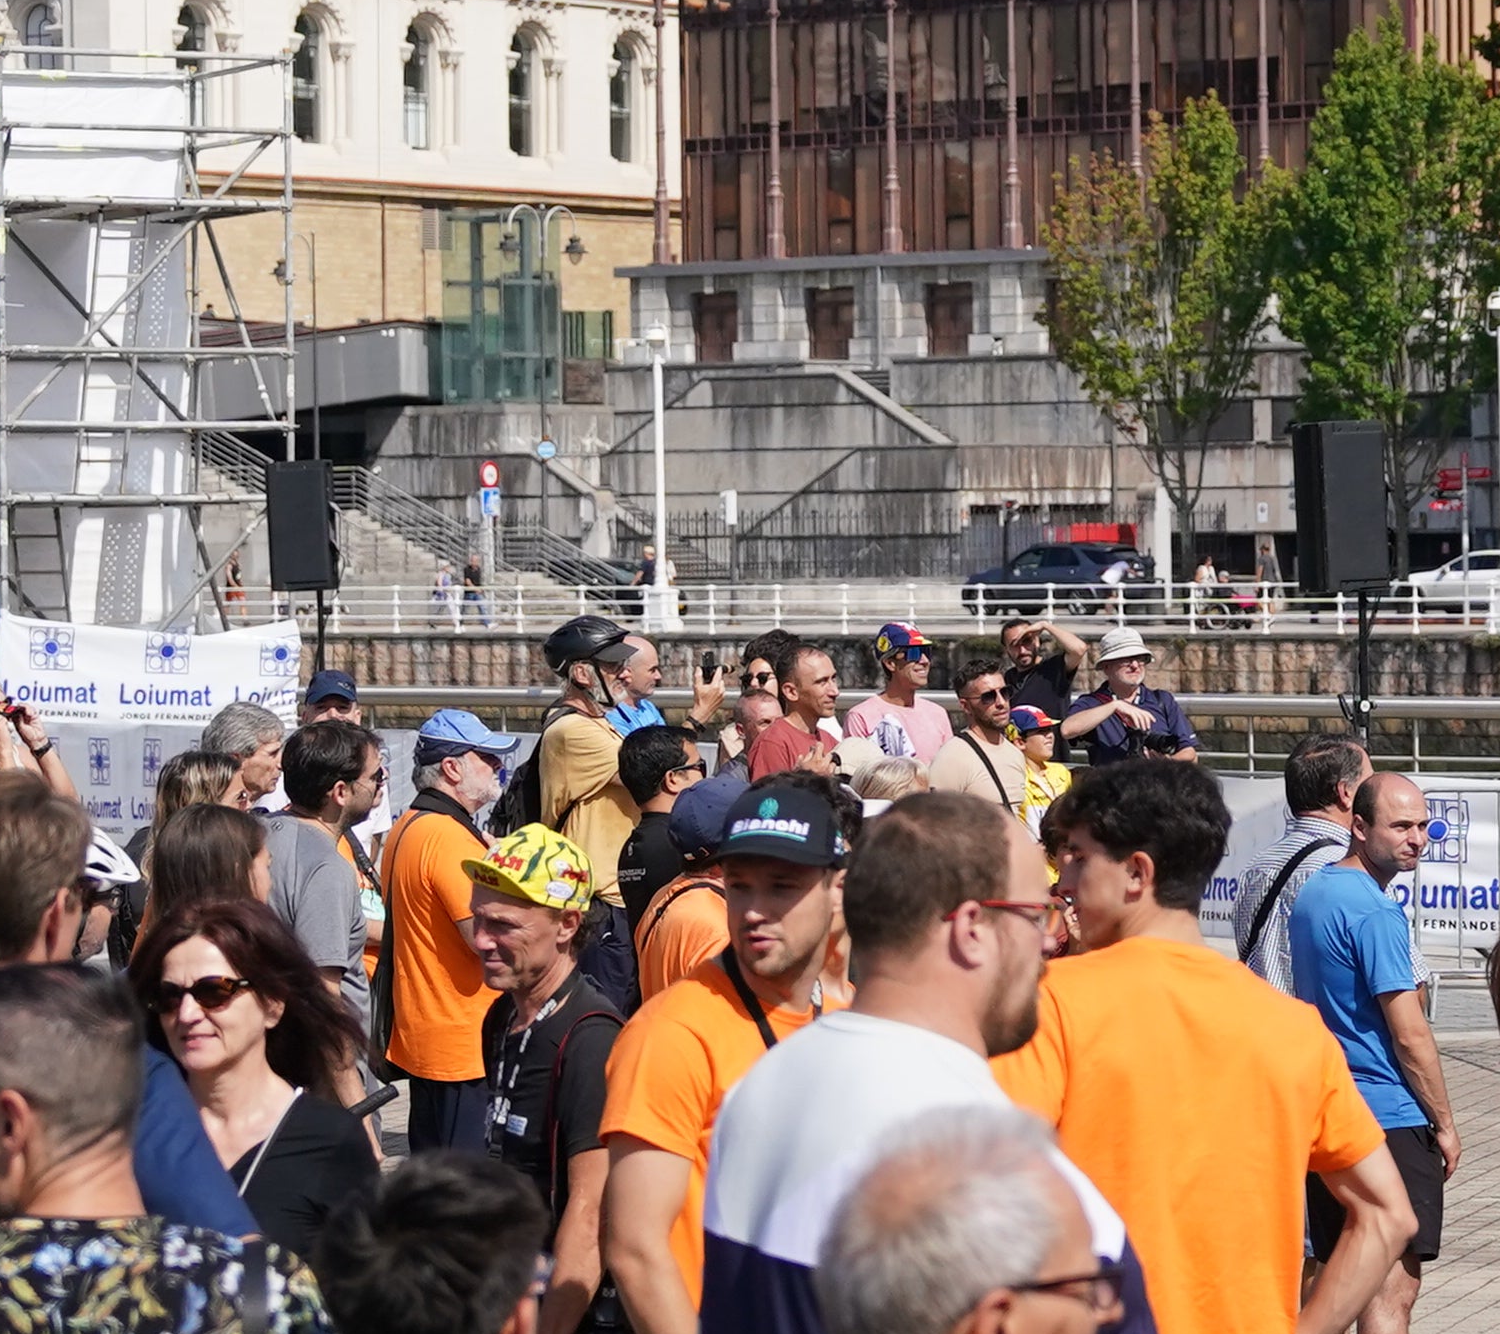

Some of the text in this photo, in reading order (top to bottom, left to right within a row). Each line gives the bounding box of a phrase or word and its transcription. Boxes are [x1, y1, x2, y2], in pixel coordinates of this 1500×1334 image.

[4, 680, 97, 704] Loiumat
[120, 683, 212, 707] Loiumat
[120, 712, 151, 721] JORGE
[81, 797, 122, 820] oiumat
[131, 796, 154, 820] Loiu
[729, 818, 811, 839] Bianchi
[1397, 878, 1500, 911] oumat
[1423, 918, 1496, 932] FERNÁNDE
